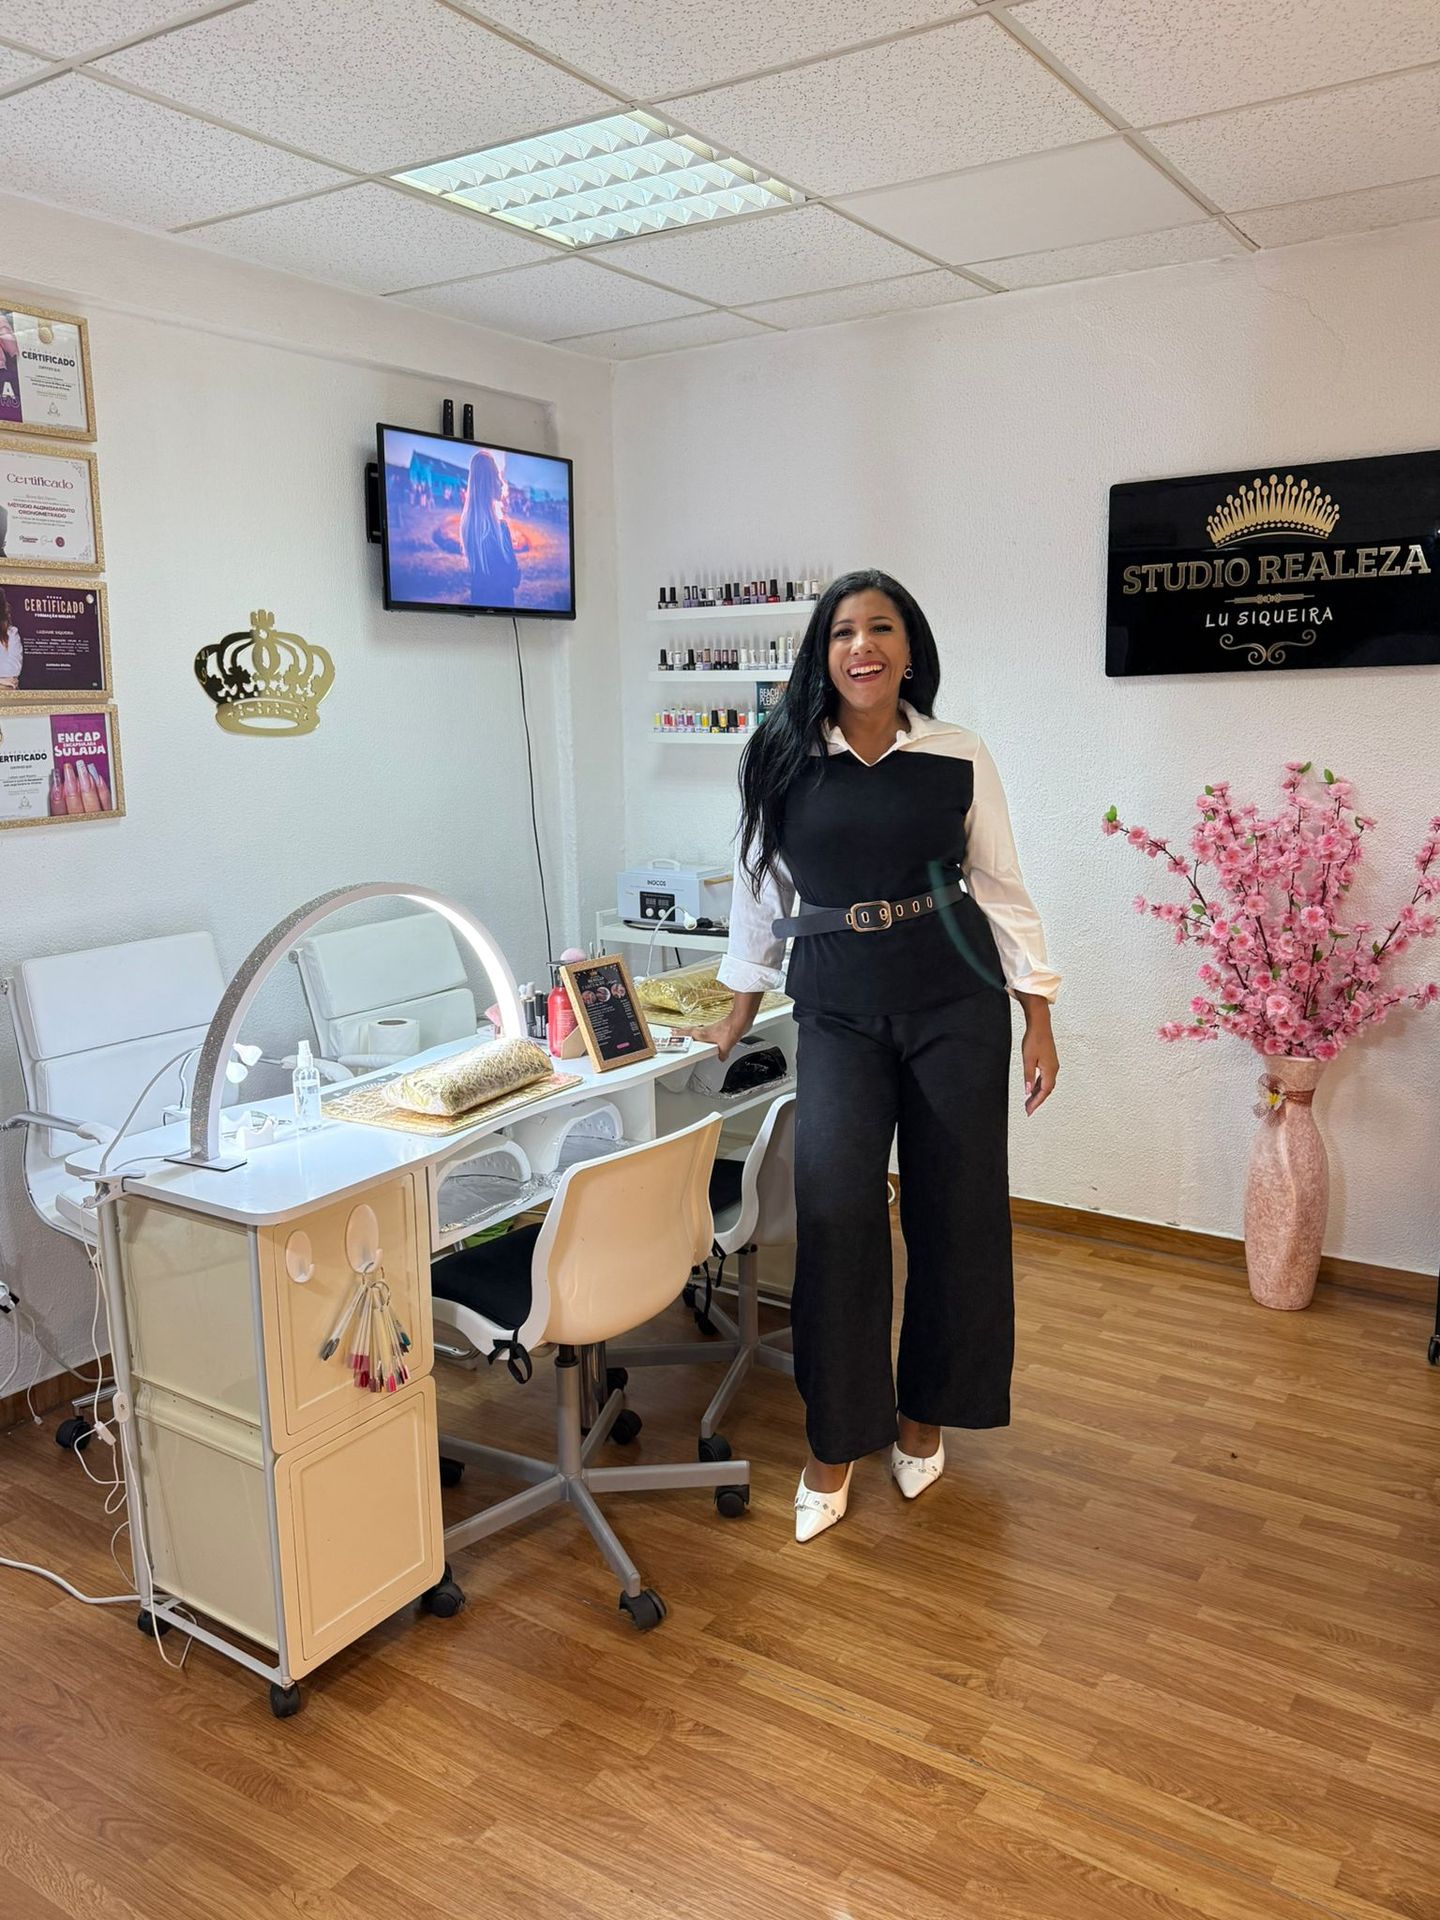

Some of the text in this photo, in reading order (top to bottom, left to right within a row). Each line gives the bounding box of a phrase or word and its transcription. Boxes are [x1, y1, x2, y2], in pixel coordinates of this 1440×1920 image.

[21, 351, 75, 368] CERTIFICADO
[6, 472, 74, 490] Certificado
[1122, 544, 1432, 594] STUDIO REALEZA
[24, 598, 85, 615] CERTIFICADO
[1205, 606, 1334, 628] LU SIQUEIRA
[57, 731, 101, 743] ENCAP
[54, 744, 106, 757] SULADA
